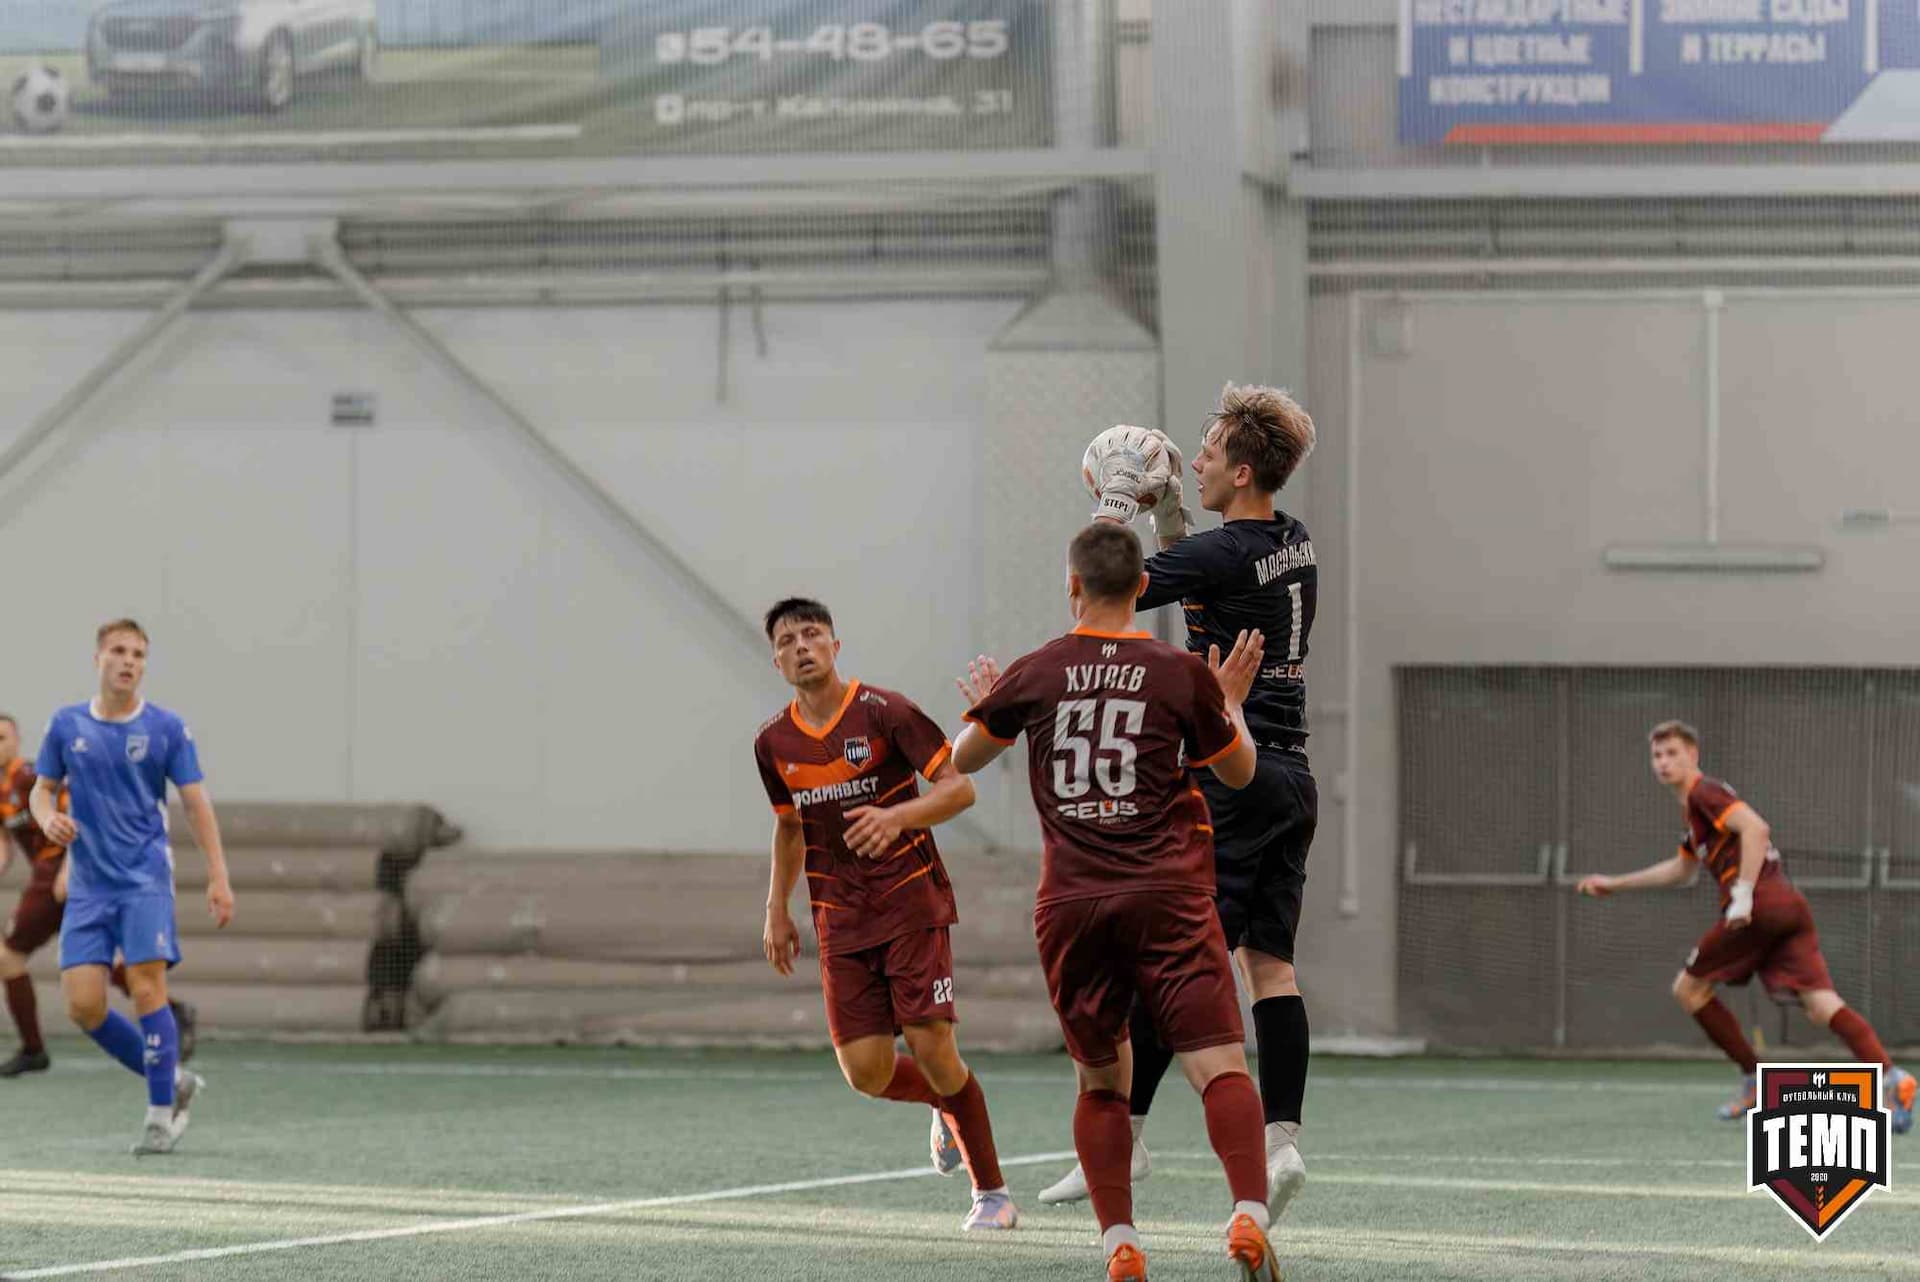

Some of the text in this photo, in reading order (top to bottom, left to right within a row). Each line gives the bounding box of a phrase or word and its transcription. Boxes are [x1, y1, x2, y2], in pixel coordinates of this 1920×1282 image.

[690, 20, 1009, 64] 54-48-65
[1708, 32, 1826, 63] ТЕРРАСЫ
[1430, 75, 1610, 105] КОНСТРУКЦИИ
[1288, 582, 1302, 661] 1
[1065, 664, 1147, 693] ХУГАЕВ
[1053, 698, 1147, 799] 55
[933, 977, 953, 1005] 22
